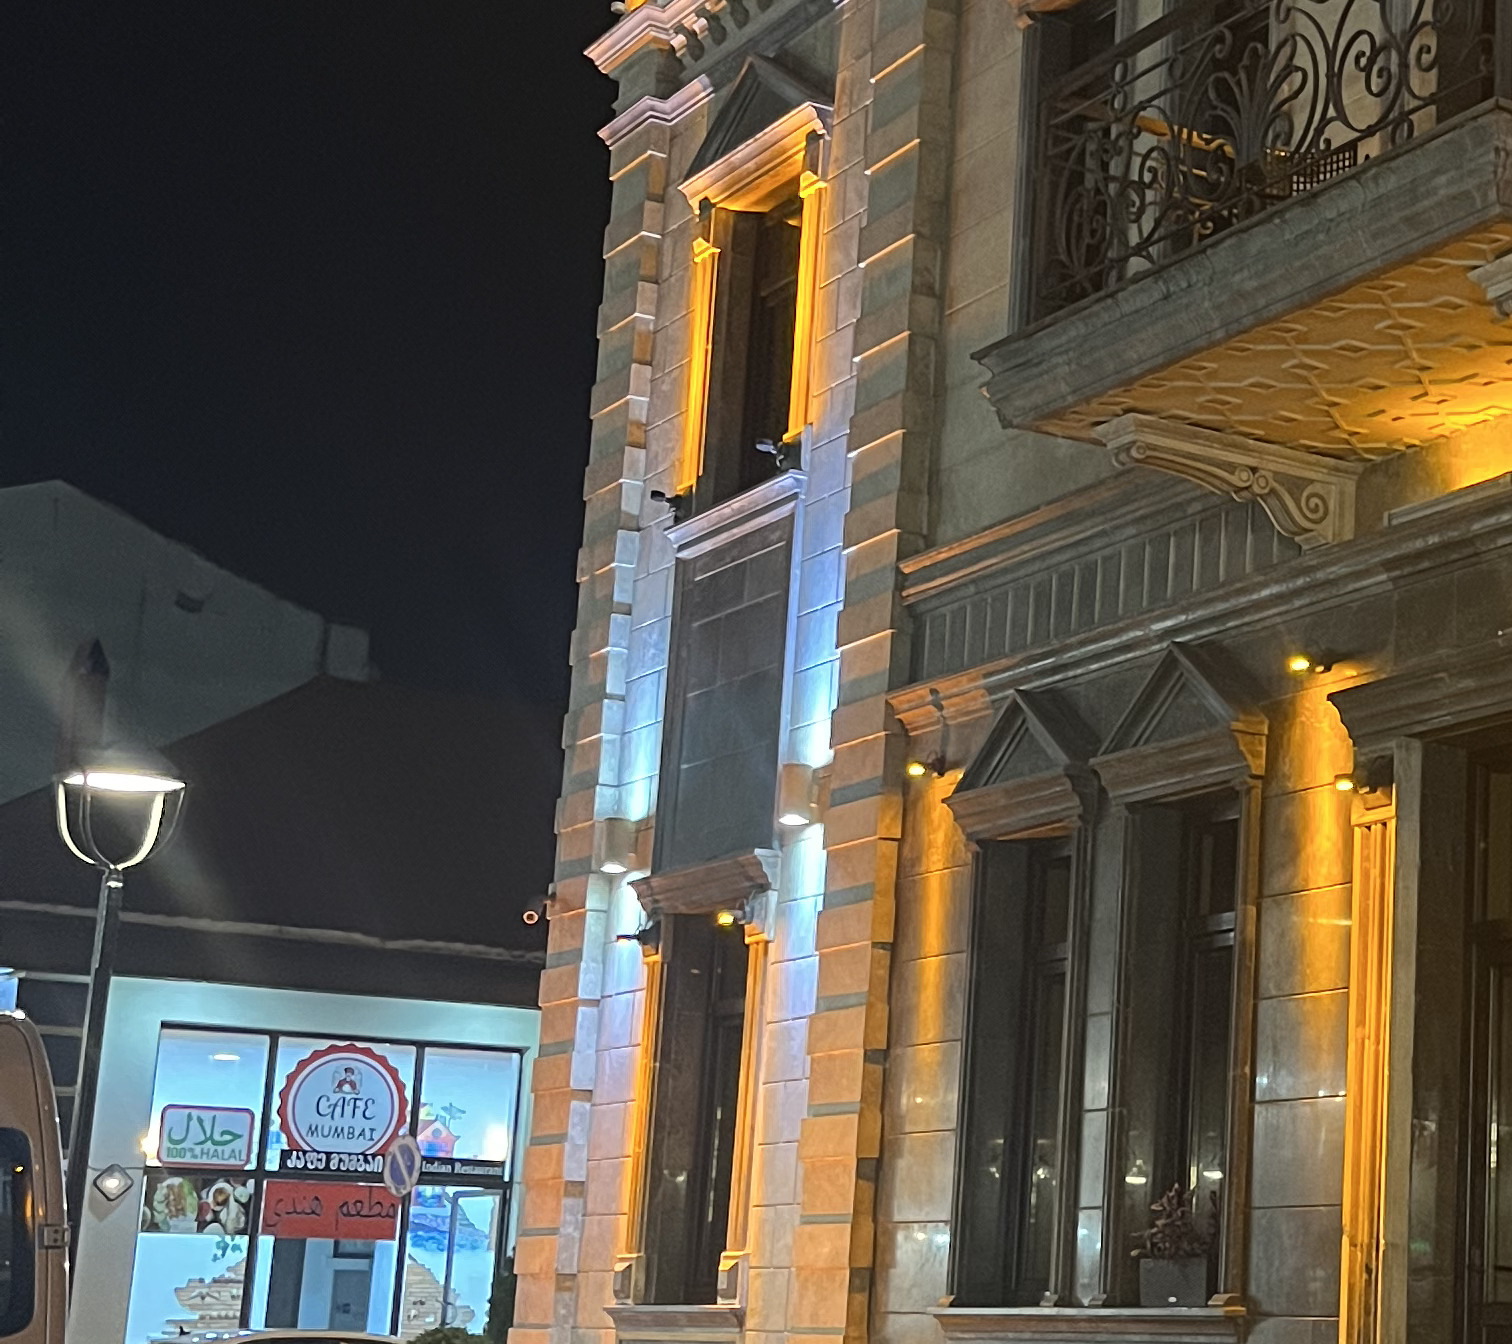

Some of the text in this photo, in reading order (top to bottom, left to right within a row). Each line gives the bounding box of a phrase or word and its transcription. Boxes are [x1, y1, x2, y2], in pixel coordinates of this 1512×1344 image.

[316, 1095, 376, 1121] CAFE
[167, 1112, 244, 1146] حلال
[306, 1123, 377, 1142] MUMBAI
[421, 1160, 452, 1174] Indian
[335, 1186, 396, 1232] مطعم
